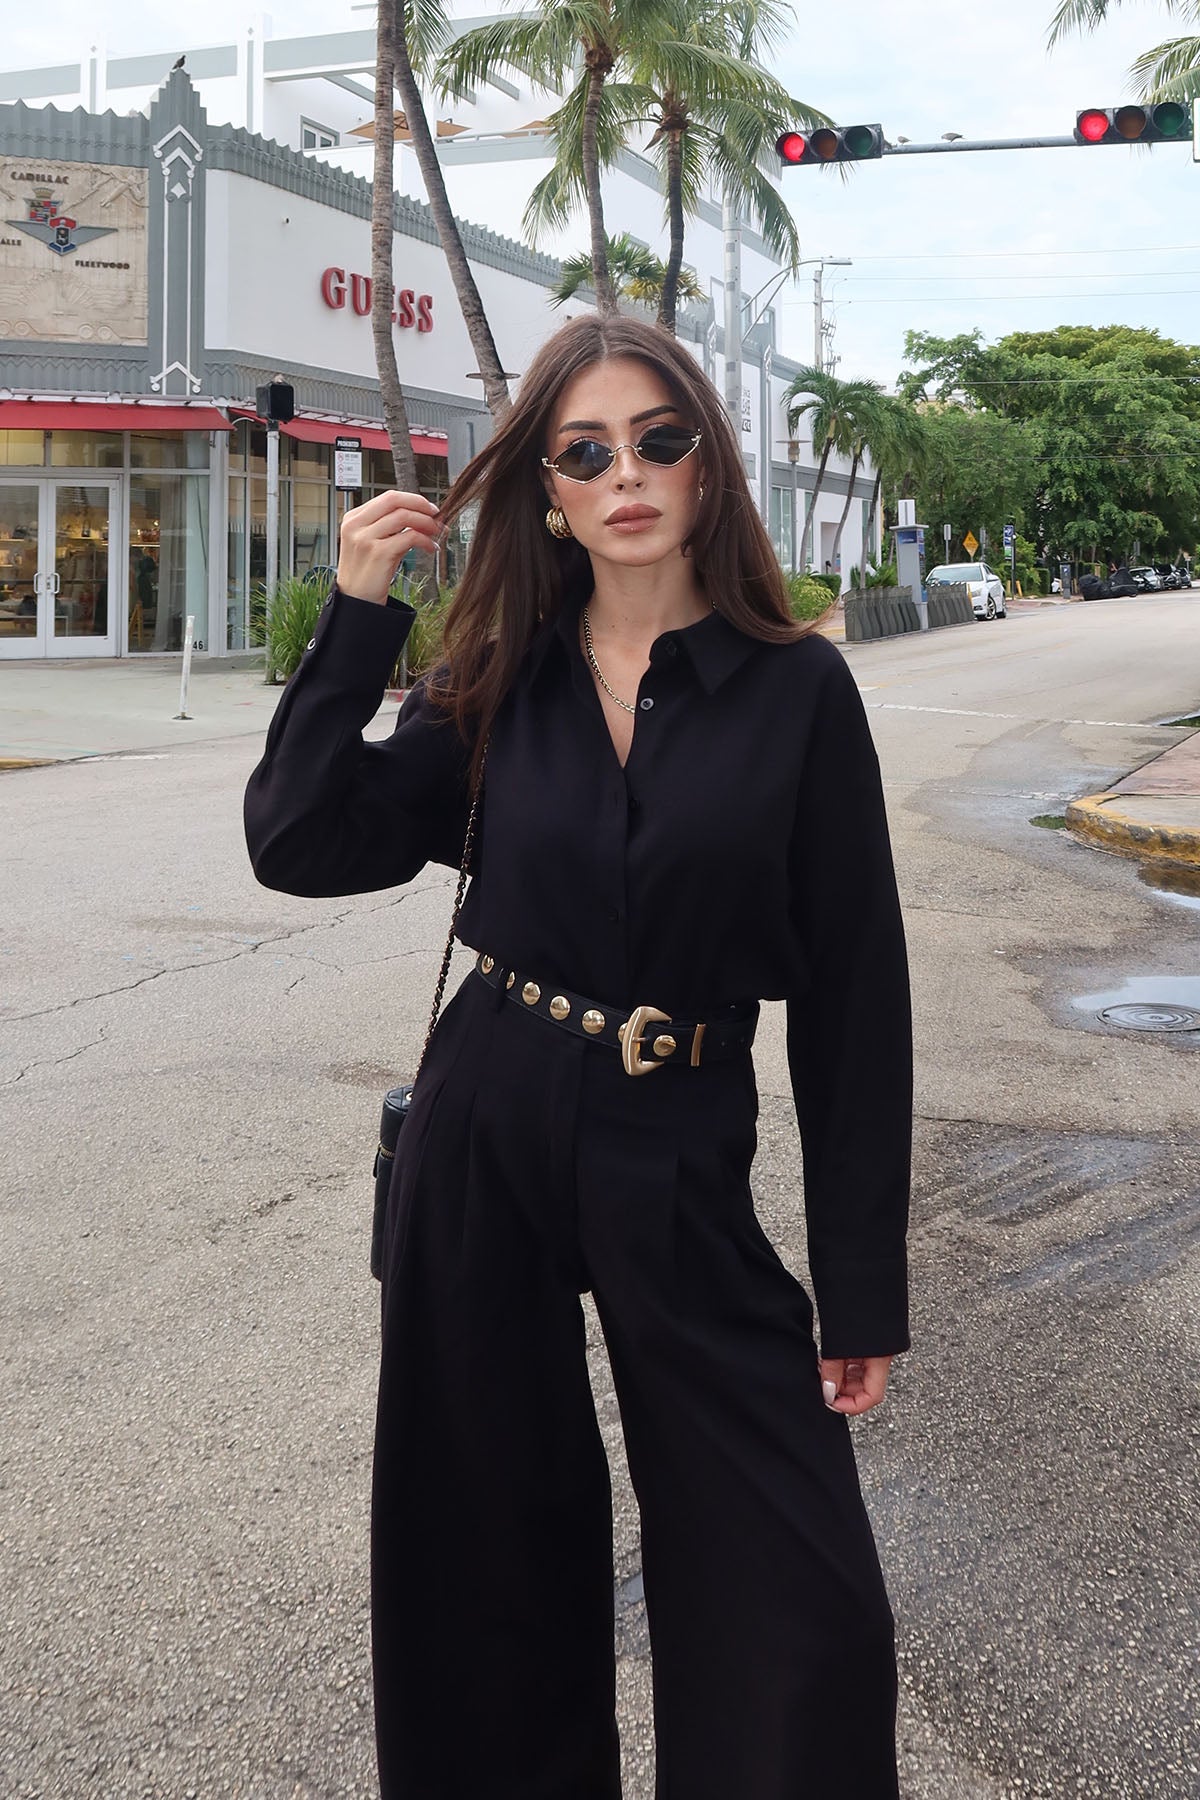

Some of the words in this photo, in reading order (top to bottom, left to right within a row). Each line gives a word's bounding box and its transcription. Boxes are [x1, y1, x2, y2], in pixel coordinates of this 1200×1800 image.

[10, 171, 69, 185] CADILLAC
[75, 260, 130, 270] FLEETWOOD
[321, 267, 433, 333] GUSS
